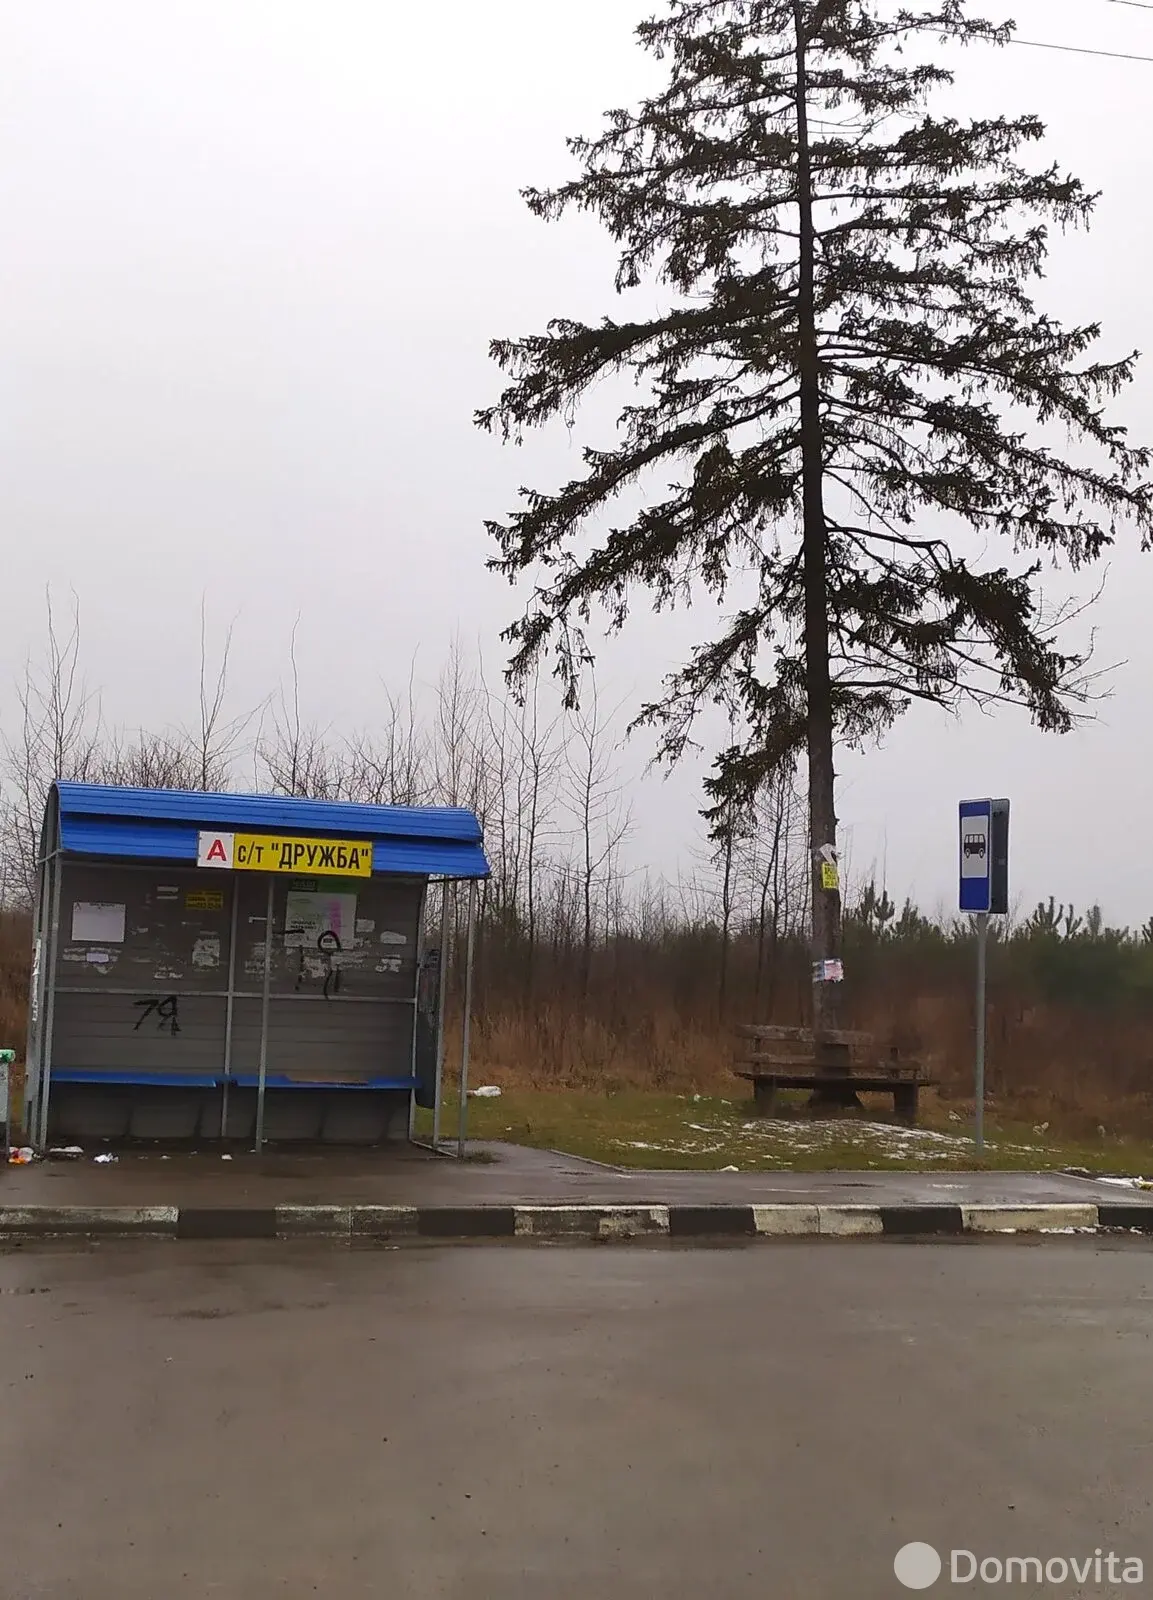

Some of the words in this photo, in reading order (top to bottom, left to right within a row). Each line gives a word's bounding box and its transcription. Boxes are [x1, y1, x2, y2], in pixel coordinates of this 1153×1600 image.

[207, 839, 227, 861] А
[238, 841, 264, 865] с/т
[271, 843, 368, 870] "ДРУЖБА"
